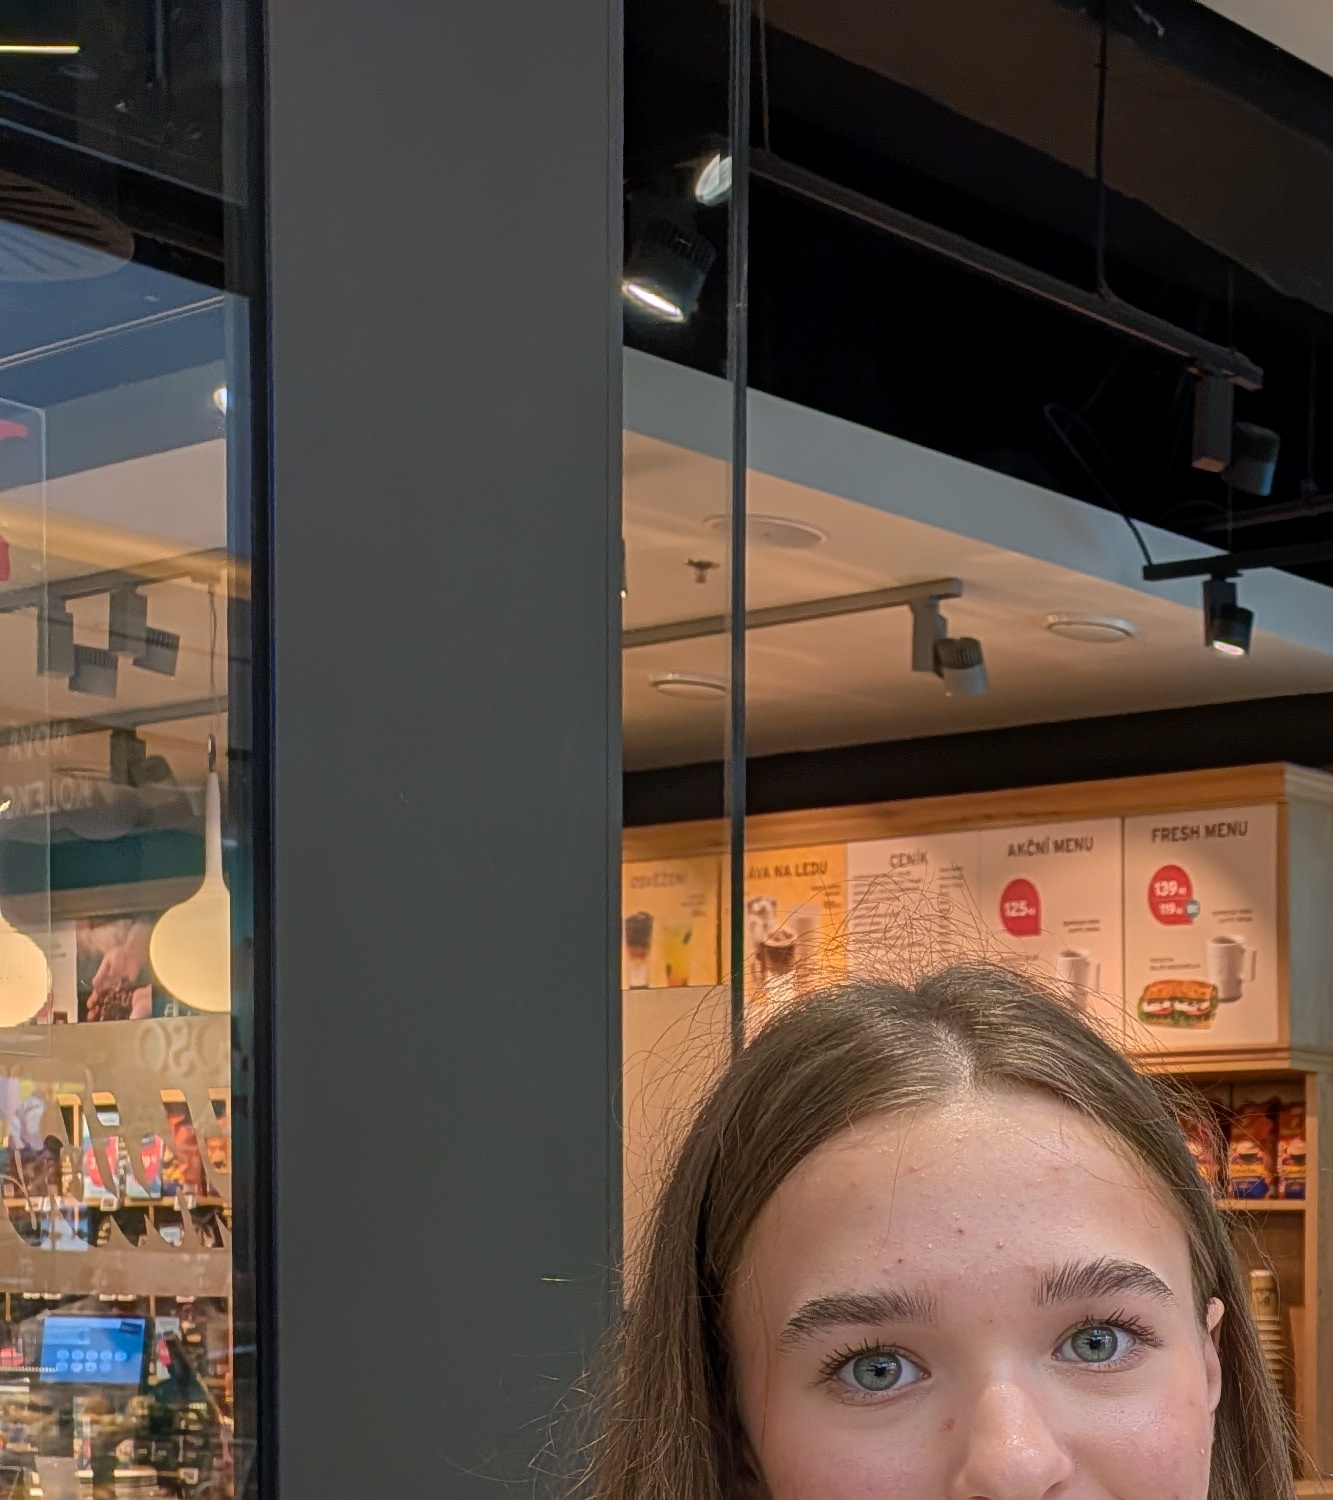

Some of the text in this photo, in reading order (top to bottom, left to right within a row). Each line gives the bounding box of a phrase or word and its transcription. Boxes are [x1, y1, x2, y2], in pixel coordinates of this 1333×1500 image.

[1152, 821, 1248, 843] FRESH MENU
[1053, 836, 1094, 853] MENU
